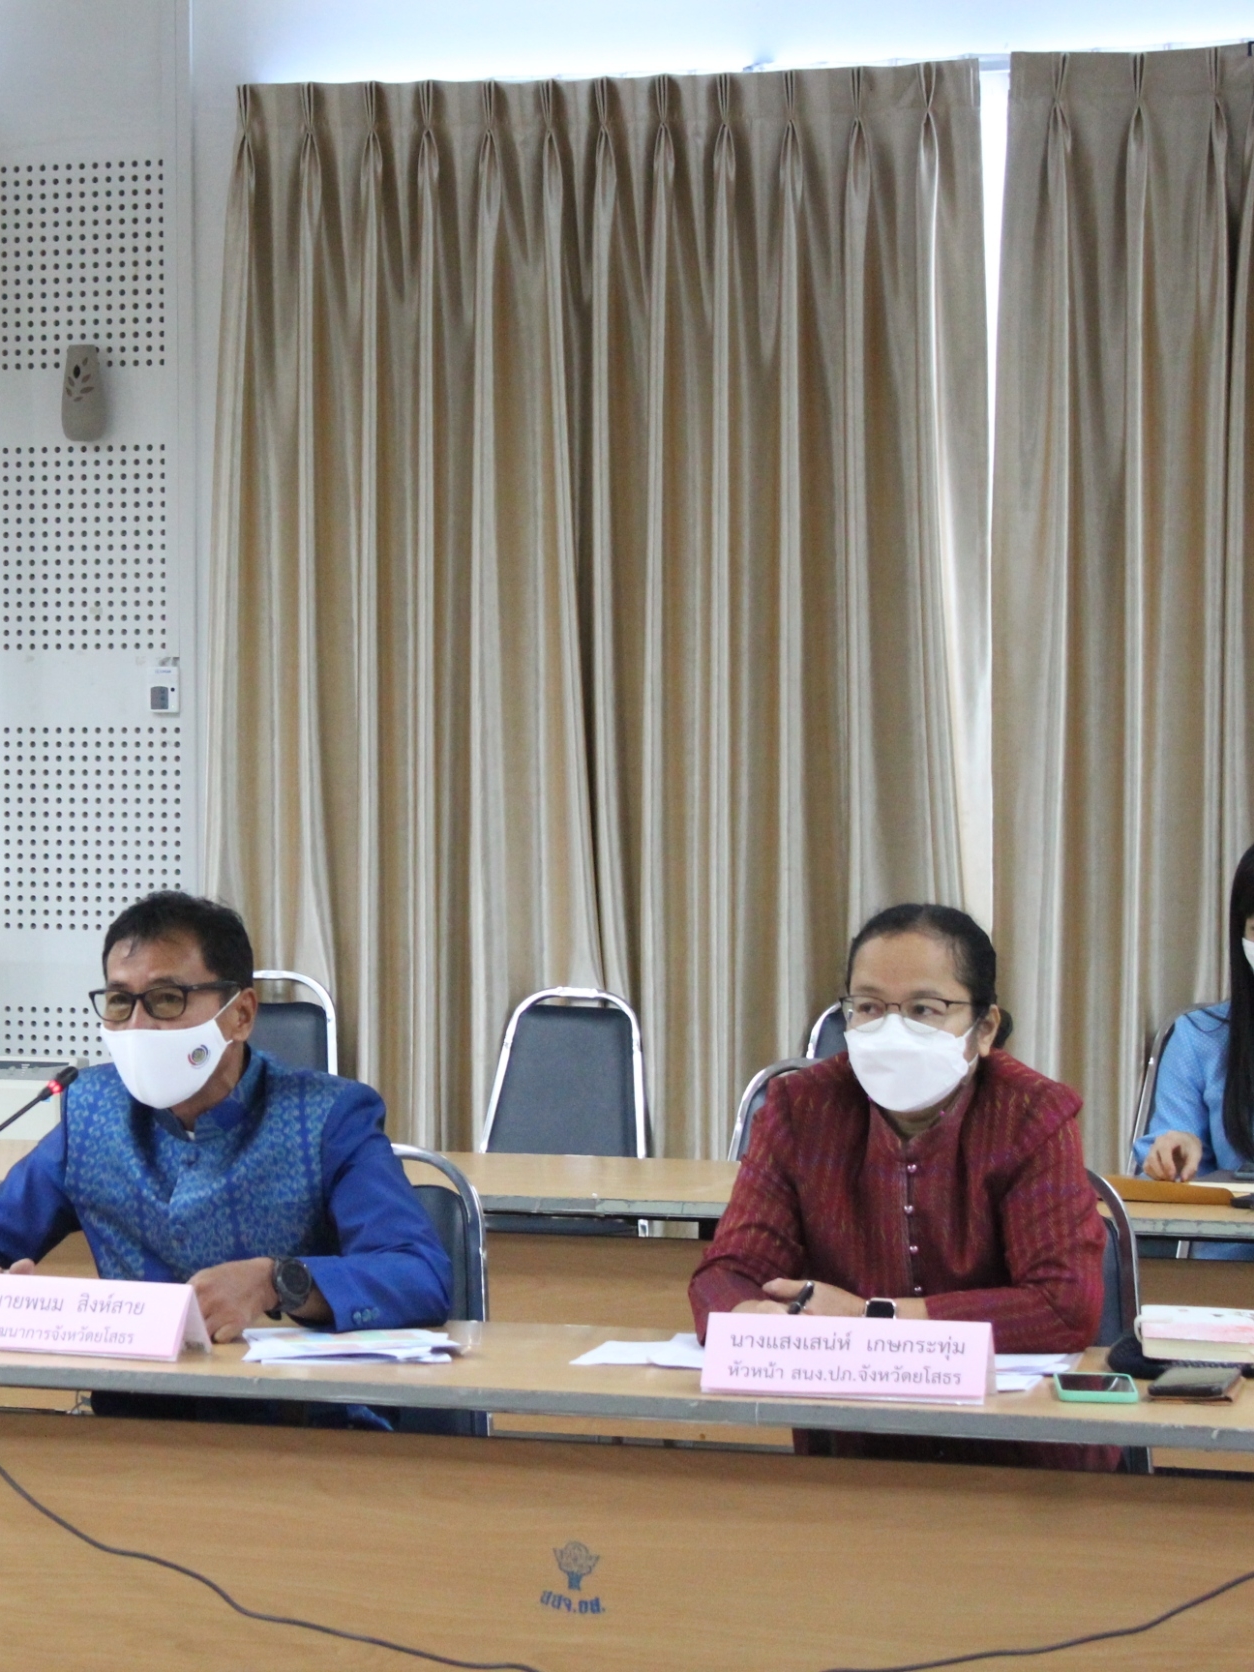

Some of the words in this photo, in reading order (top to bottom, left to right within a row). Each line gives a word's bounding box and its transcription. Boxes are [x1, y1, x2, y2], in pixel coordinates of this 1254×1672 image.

[76, 1292, 145, 1316] สิงห์สาย
[730, 1331, 852, 1352] นางแสงเสน่ห์
[866, 1335, 966, 1361] เกษกระทุ่ม
[727, 1359, 784, 1380] หัวหน้า
[791, 1363, 962, 1386] สนง.ปภ.จังหวัดยโสธร
